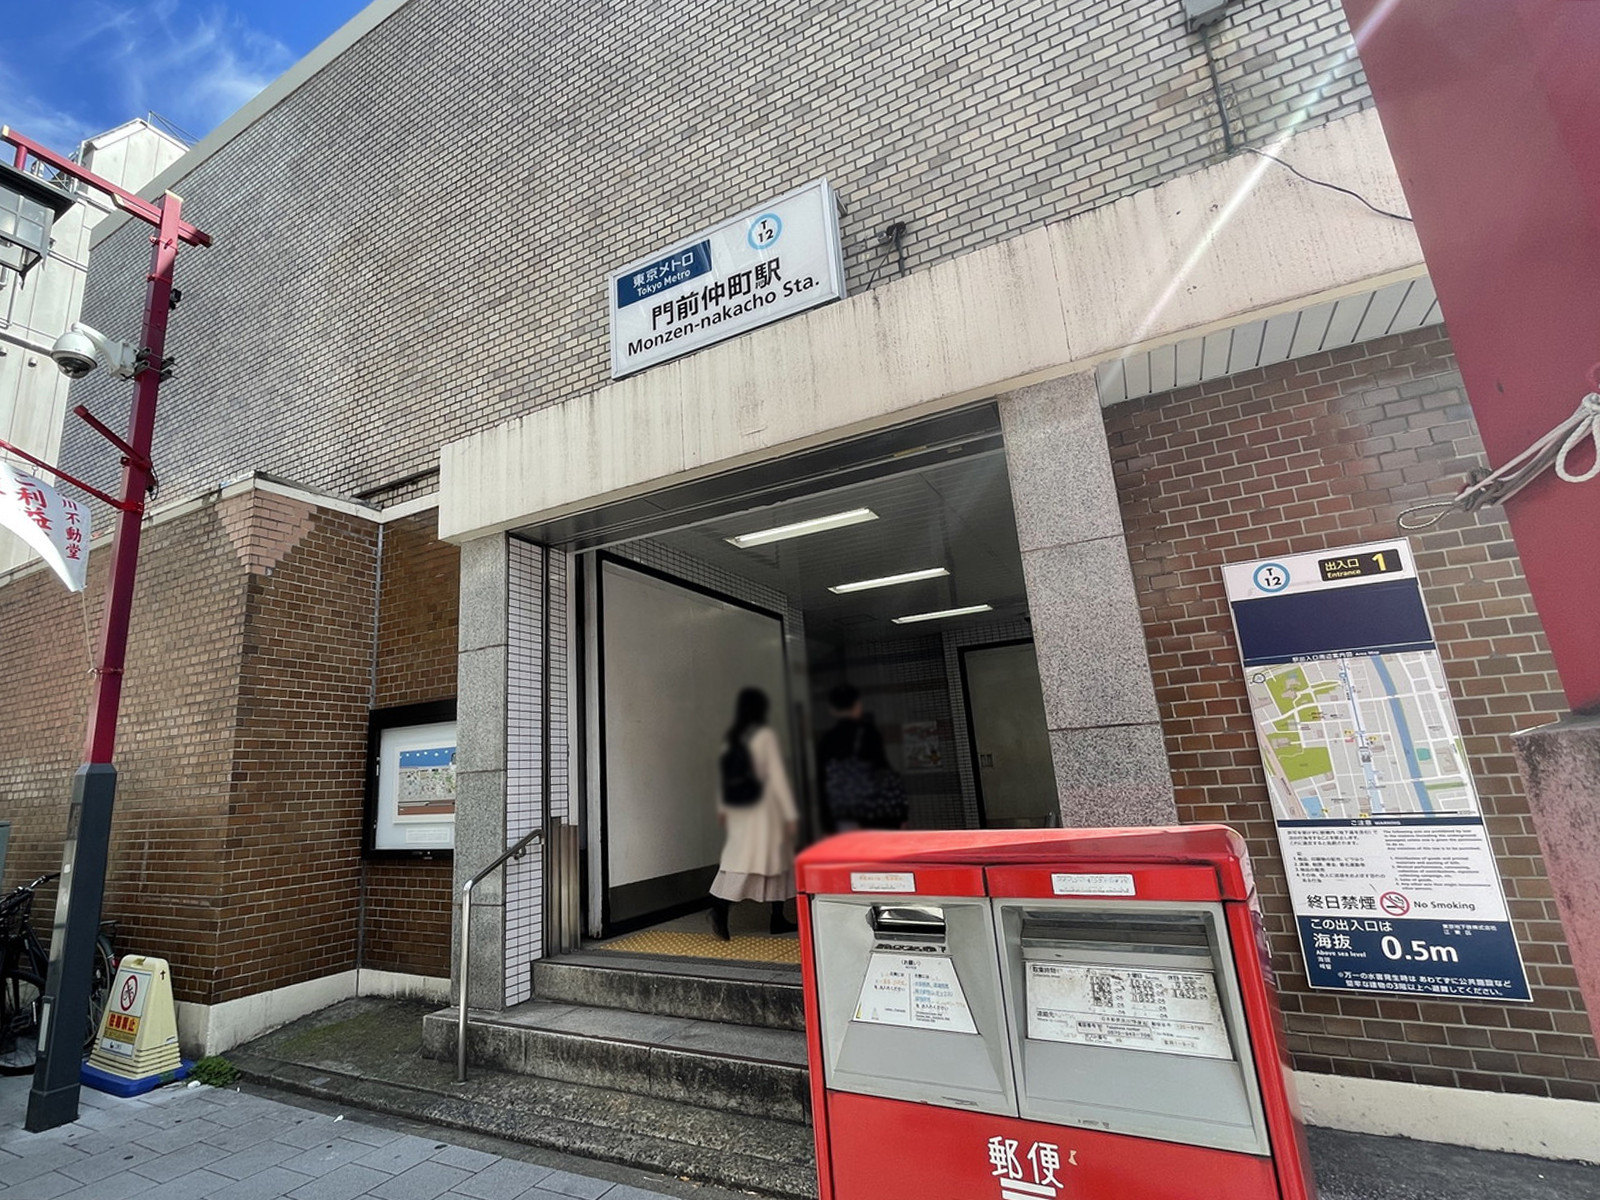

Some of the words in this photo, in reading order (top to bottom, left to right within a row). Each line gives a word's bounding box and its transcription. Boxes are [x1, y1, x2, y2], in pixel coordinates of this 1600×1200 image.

[760, 220, 768, 230] T
[758, 229, 774, 243] 12
[632, 252, 694, 289] 東京メトロ
[637, 281, 663, 297] Tokyo
[663, 268, 691, 287] Metro
[651, 257, 783, 331] 門前仲町駅
[627, 290, 778, 357] Monzen-nakacho
[782, 276, 820, 298] Sta.
[61, 495, 82, 561] 川不動堂
[1324, 558, 1360, 572] 出入口
[1371, 552, 1387, 572] 1
[1266, 568, 1274, 576] T
[1326, 568, 1361, 579] Entrance
[1264, 576, 1282, 587] 12
[1306, 894, 1377, 911] 終日禁煙
[1413, 901, 1428, 909] No
[1430, 900, 1476, 912] Smoking
[1310, 918, 1393, 932] この出入口は
[1313, 932, 1352, 950] 海抜
[1381, 935, 1459, 963] 0.5m
[987, 1135, 1065, 1189] 郵便
